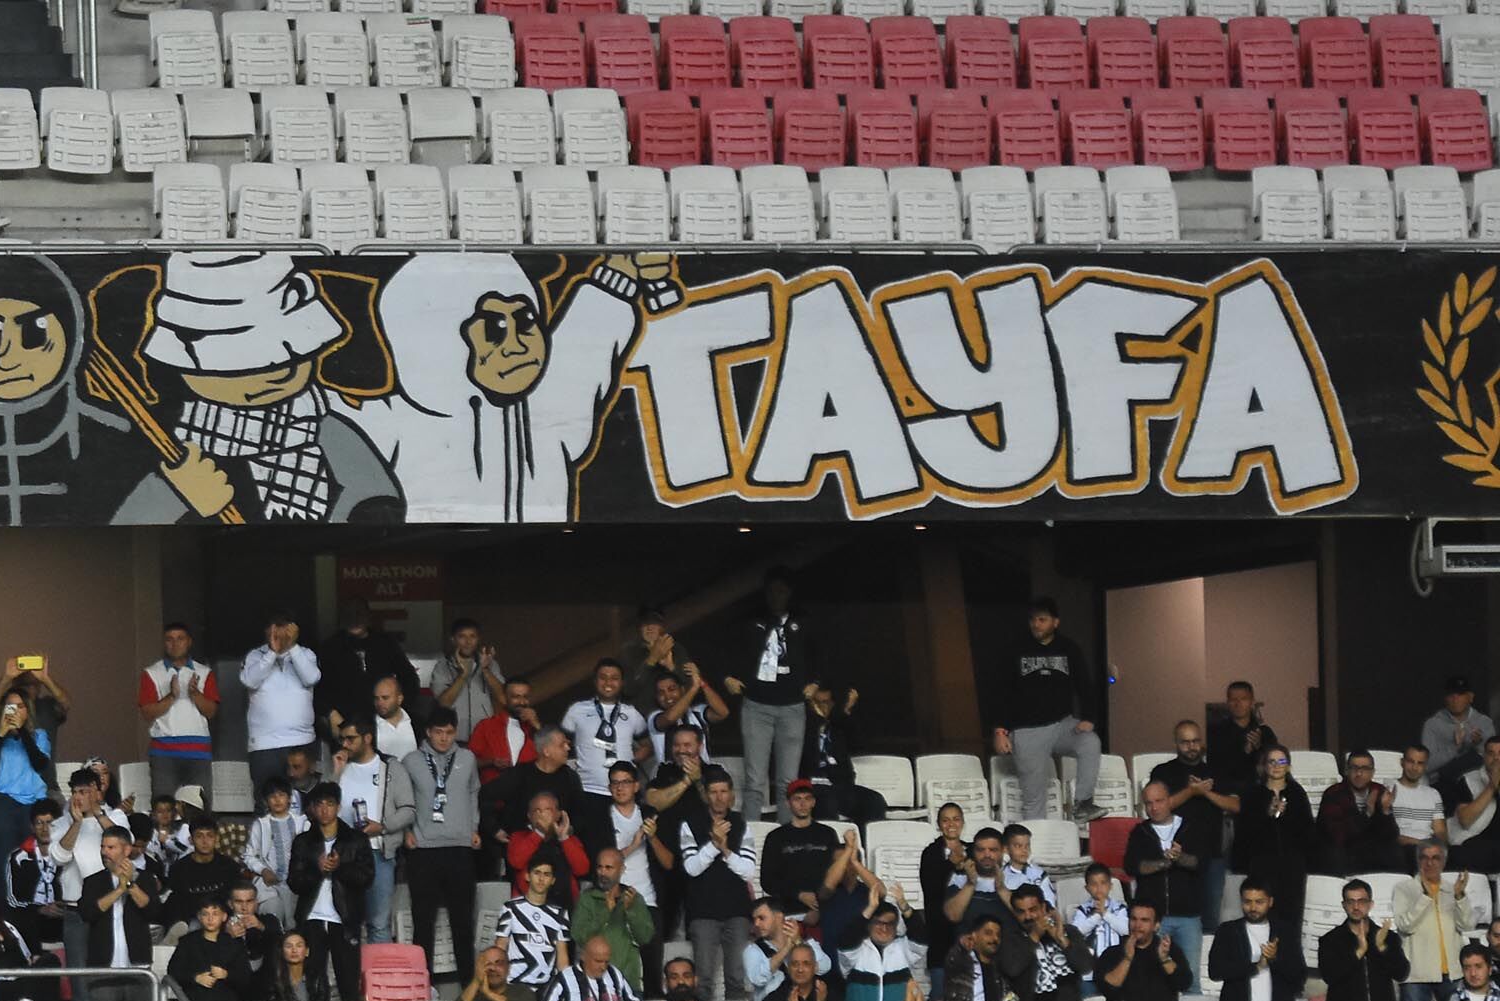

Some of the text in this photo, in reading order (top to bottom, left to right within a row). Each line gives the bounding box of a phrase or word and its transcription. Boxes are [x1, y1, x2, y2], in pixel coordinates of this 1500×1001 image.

[622, 257, 1360, 521] TAYFA
[343, 565, 438, 579] MARATHON
[376, 582, 406, 595] ALT
